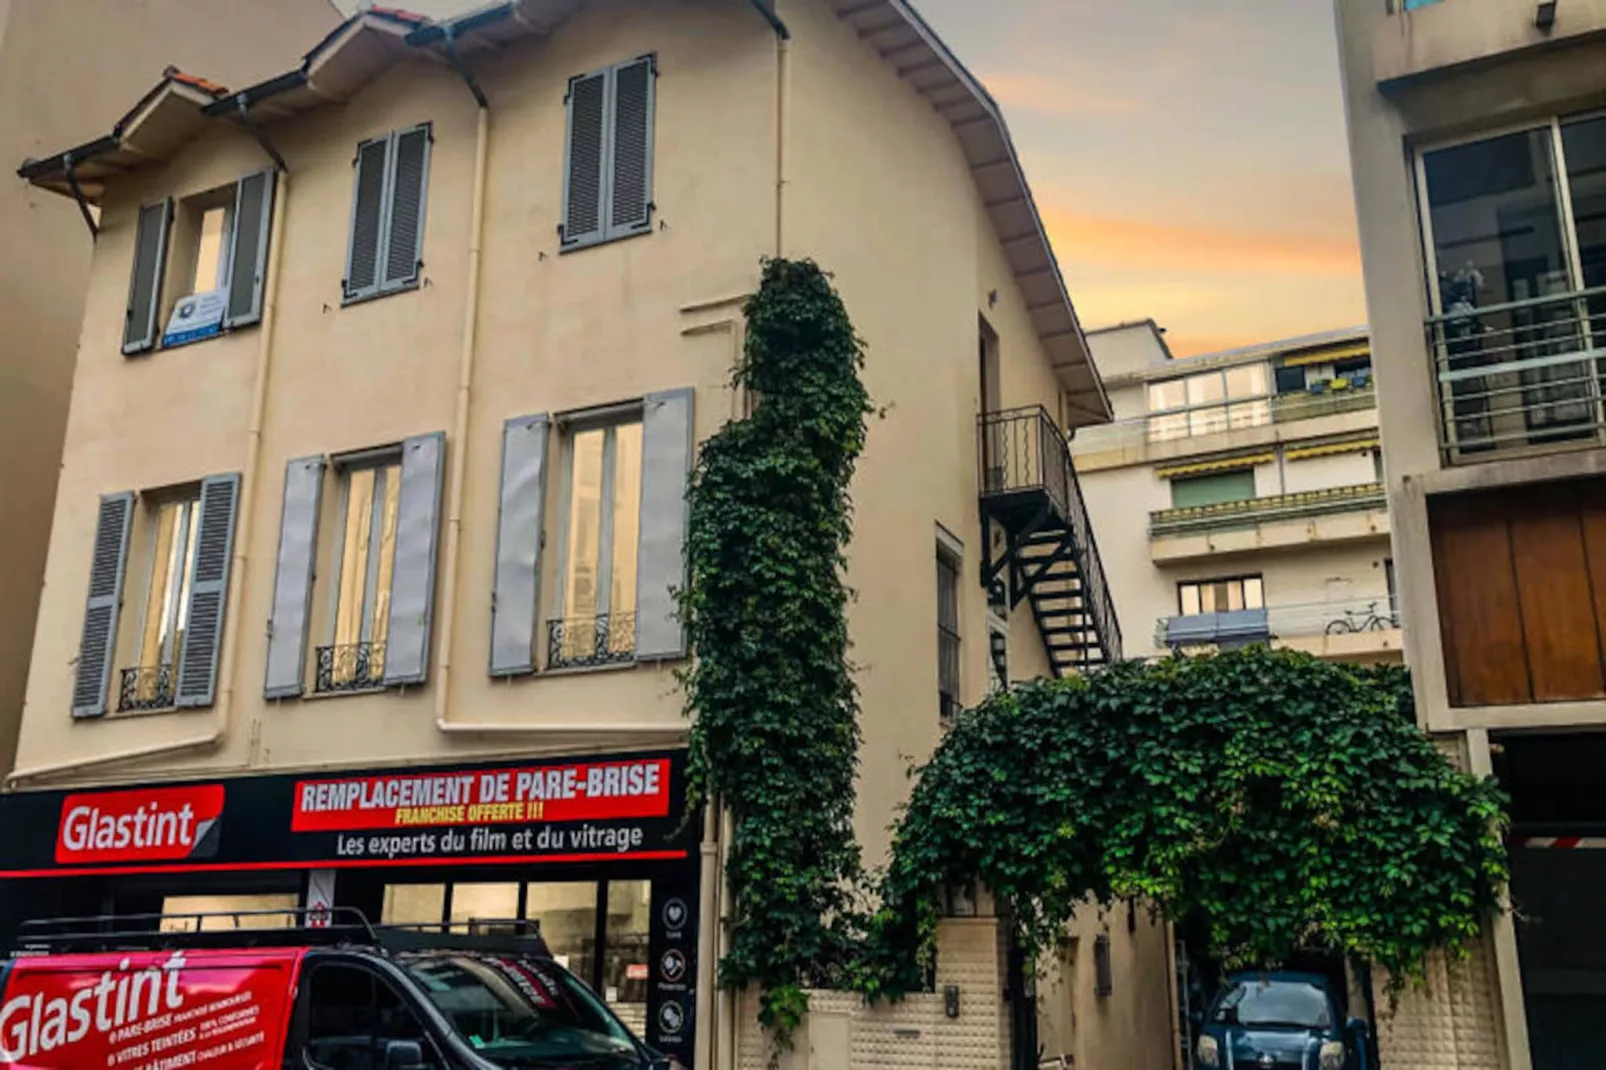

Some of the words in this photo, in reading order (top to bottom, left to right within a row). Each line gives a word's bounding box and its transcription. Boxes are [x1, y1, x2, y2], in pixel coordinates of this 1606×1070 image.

[301, 776, 474, 812] REMPLACEMENT
[479, 773, 512, 803] DE
[515, 763, 660, 802] PARE-BRISE
[62, 801, 194, 852] Glastint
[394, 803, 465, 824] FRANCHISE
[467, 801, 525, 822] OFFERTE
[336, 834, 365, 856] Les
[368, 833, 436, 859] experts
[440, 828, 465, 852] du
[470, 827, 507, 851] film
[511, 828, 532, 850] et
[536, 825, 563, 849] du
[568, 824, 643, 852] vitrage
[0, 950, 187, 1063] Glastint
[115, 1041, 149, 1064] VITRES
